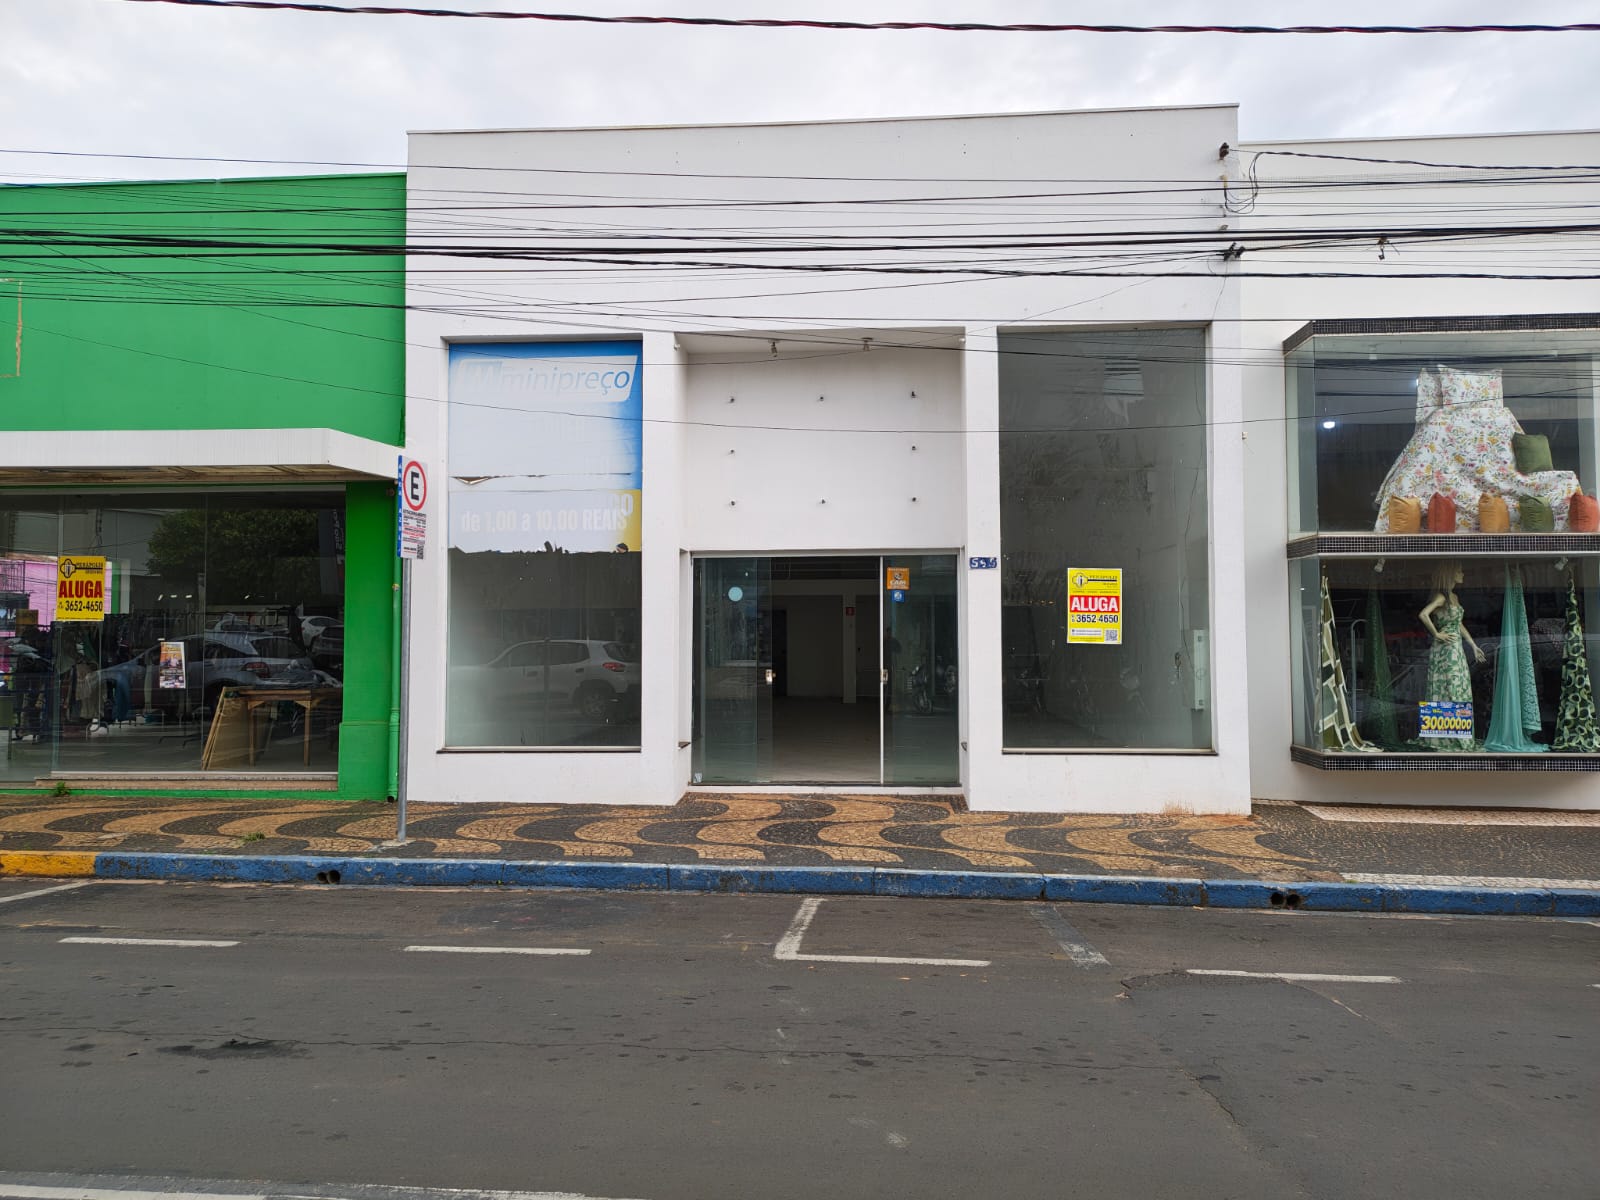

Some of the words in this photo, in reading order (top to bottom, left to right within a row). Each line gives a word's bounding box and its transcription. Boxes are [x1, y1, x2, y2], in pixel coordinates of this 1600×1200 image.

[411, 471, 420, 501] E
[461, 510, 481, 532] de
[521, 512, 531, 532] a
[582, 508, 627, 531] REAIS
[59, 580, 103, 598] ALUGA
[65, 600, 103, 611] 3652-4650
[1071, 596, 1119, 612] ALUGA
